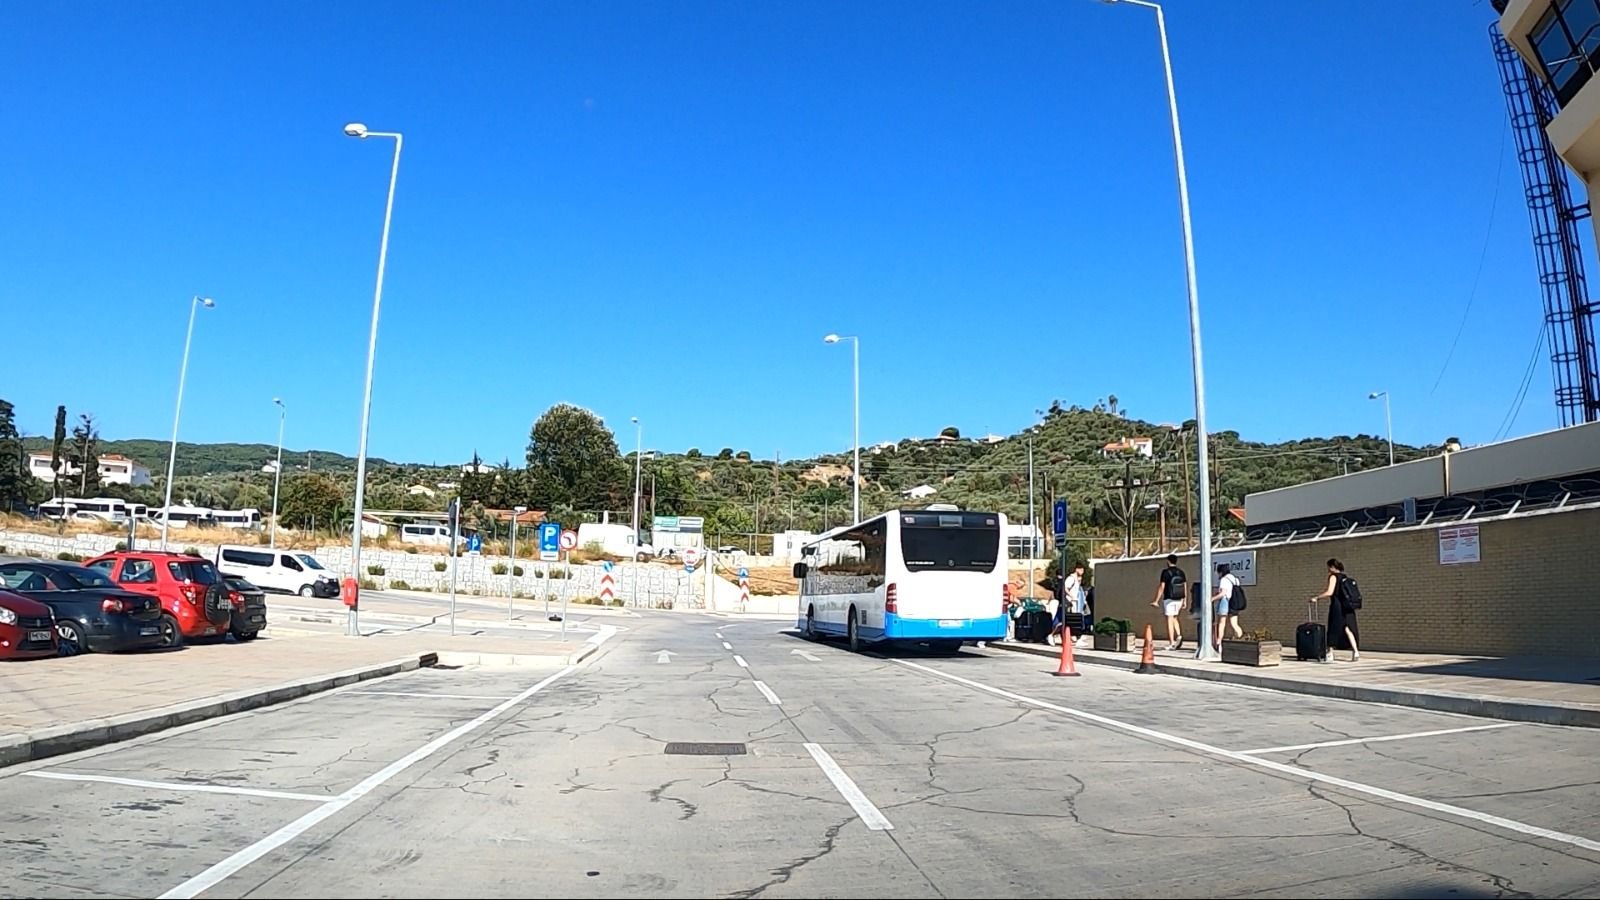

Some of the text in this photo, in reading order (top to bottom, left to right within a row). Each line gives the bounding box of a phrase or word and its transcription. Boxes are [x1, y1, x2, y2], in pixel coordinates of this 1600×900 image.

[1057, 506, 1064, 531] P
[544, 526, 556, 542] P
[472, 538, 478, 550] P
[1245, 559, 1251, 570] 2
[217, 595, 232, 612] Jeep
